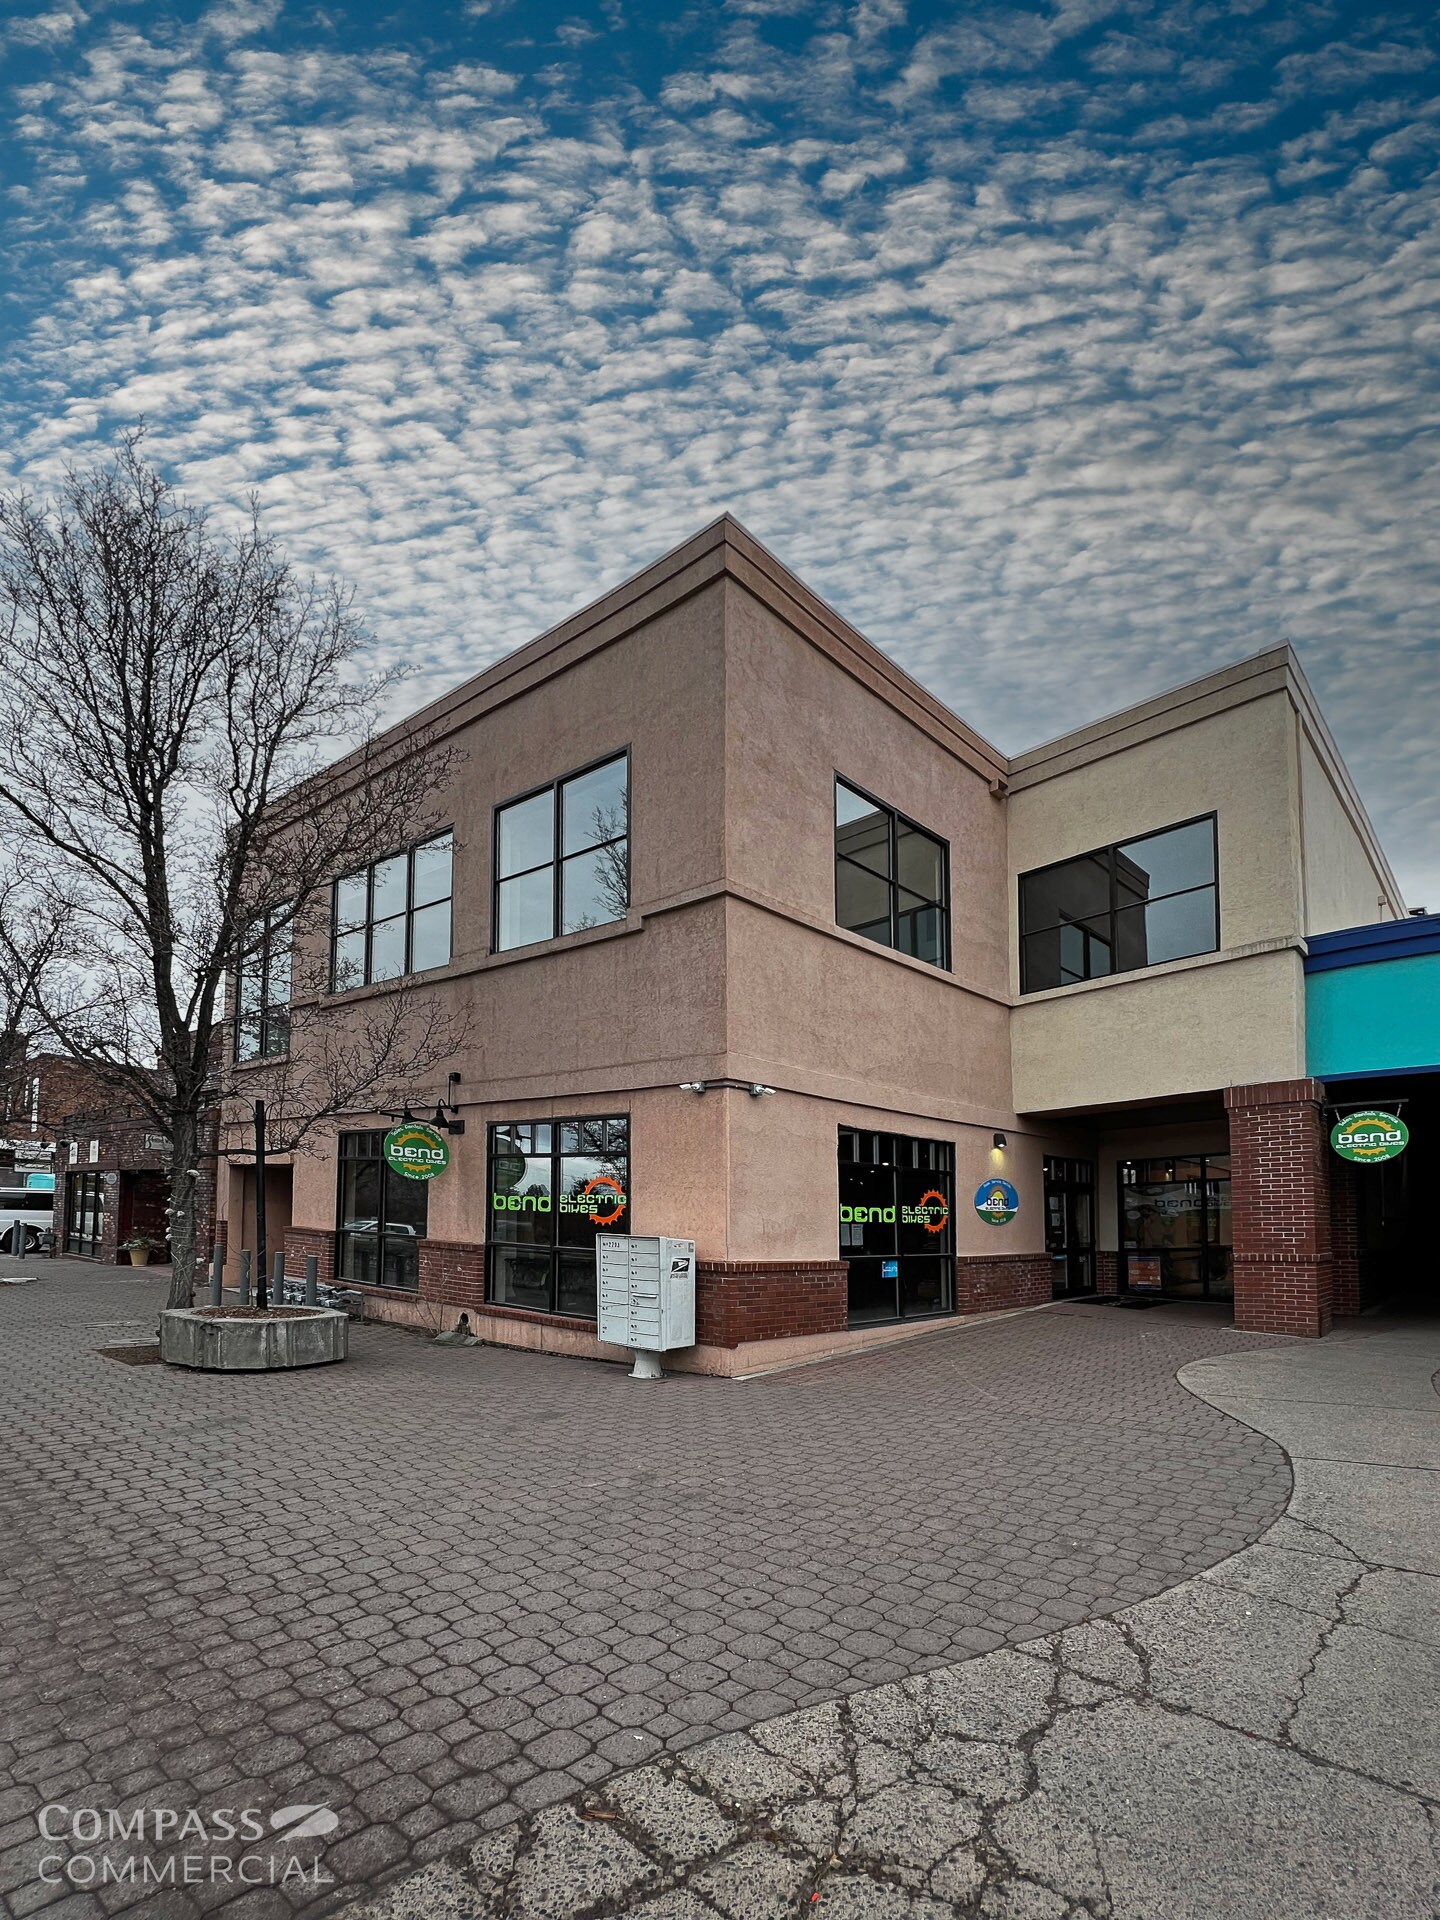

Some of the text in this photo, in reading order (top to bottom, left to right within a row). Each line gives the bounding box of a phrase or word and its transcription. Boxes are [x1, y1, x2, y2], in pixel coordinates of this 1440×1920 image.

[1338, 1130, 1401, 1144] bend
[390, 1144, 444, 1160] bend
[493, 1193, 551, 1212] bend
[840, 1203, 896, 1223] bend
